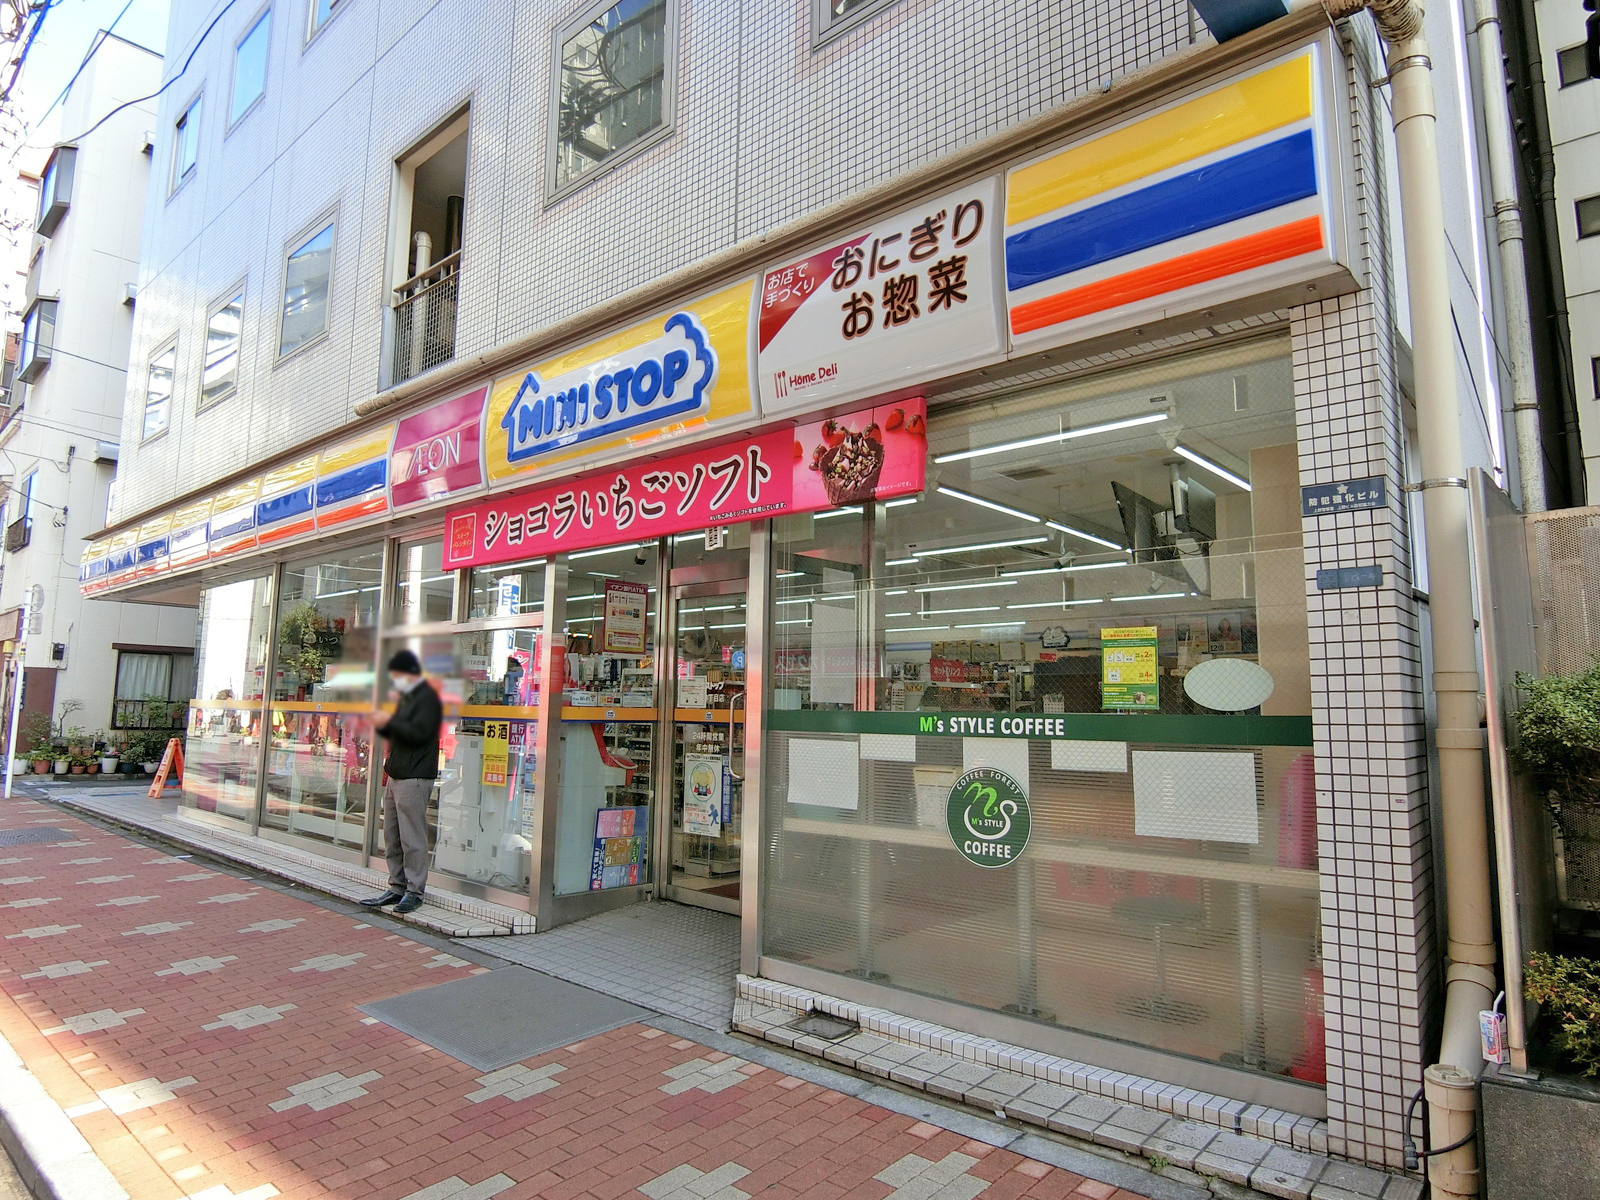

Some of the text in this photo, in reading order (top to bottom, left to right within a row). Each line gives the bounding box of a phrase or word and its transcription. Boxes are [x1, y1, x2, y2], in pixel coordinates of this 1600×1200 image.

[831, 199, 984, 292] おにぎり
[767, 262, 809, 291] お店で
[764, 278, 815, 308] 手づくり
[841, 254, 969, 341] お惣菜
[789, 372, 816, 387] Home
[818, 362, 838, 379] Deli
[484, 444, 773, 550] ショコラいちごソフト
[1308, 490, 1379, 507] 防犯強化ビル
[486, 724, 509, 740] お酒
[511, 723, 525, 735] 銀行
[919, 715, 1065, 736] M's STYLE COFFEE
[692, 731, 725, 742] 24時間営業
[695, 743, 720, 753] 年中無休
[956, 770, 1021, 795] COFFEE FOREST
[984, 819, 1004, 828] STYLE
[964, 840, 1012, 859] COFFEE
